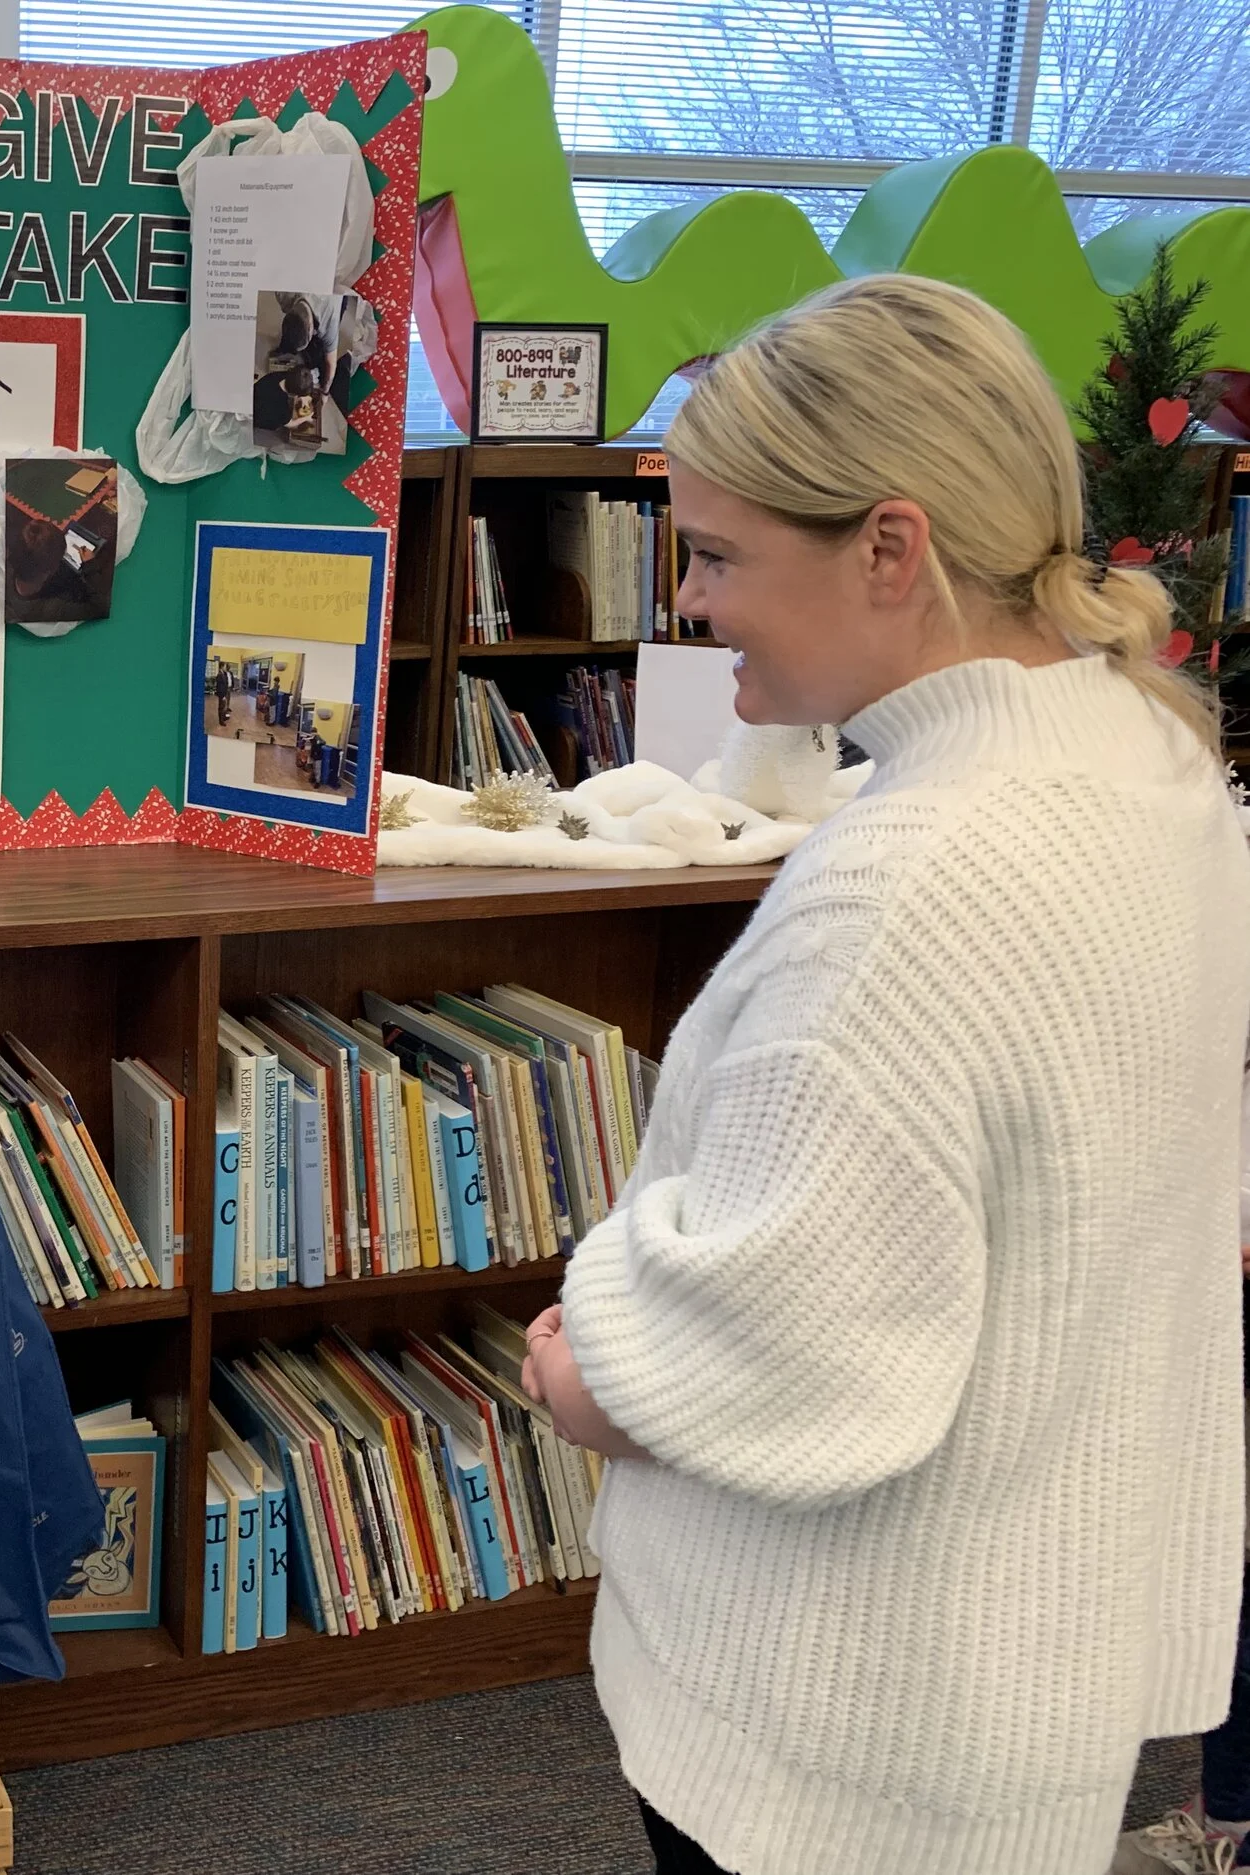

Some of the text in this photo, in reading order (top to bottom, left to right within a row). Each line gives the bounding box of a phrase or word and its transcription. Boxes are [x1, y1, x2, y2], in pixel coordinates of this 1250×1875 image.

[496, 348, 553, 363] 800-899
[506, 364, 576, 379] Literature
[241, 1069, 251, 1117] KEEPERS
[264, 1067, 275, 1117] KEEPERS
[321, 1122, 325, 1130] OF
[606, 1098, 618, 1137] MOTHER
[621, 1099, 635, 1140] MOTHER
[241, 1132, 251, 1168] EARTH
[452, 1127, 476, 1158] D
[611, 1137, 622, 1165] GOOSE
[264, 1133, 275, 1188] ANIMALS
[464, 1174, 482, 1206] d
[465, 1476, 490, 1503] L
[206, 1513, 227, 1544] I
[238, 1508, 259, 1539] J
[268, 1499, 287, 1529] K
[211, 1563, 220, 1592] i
[242, 1558, 255, 1593] j
[269, 1548, 287, 1576] k
